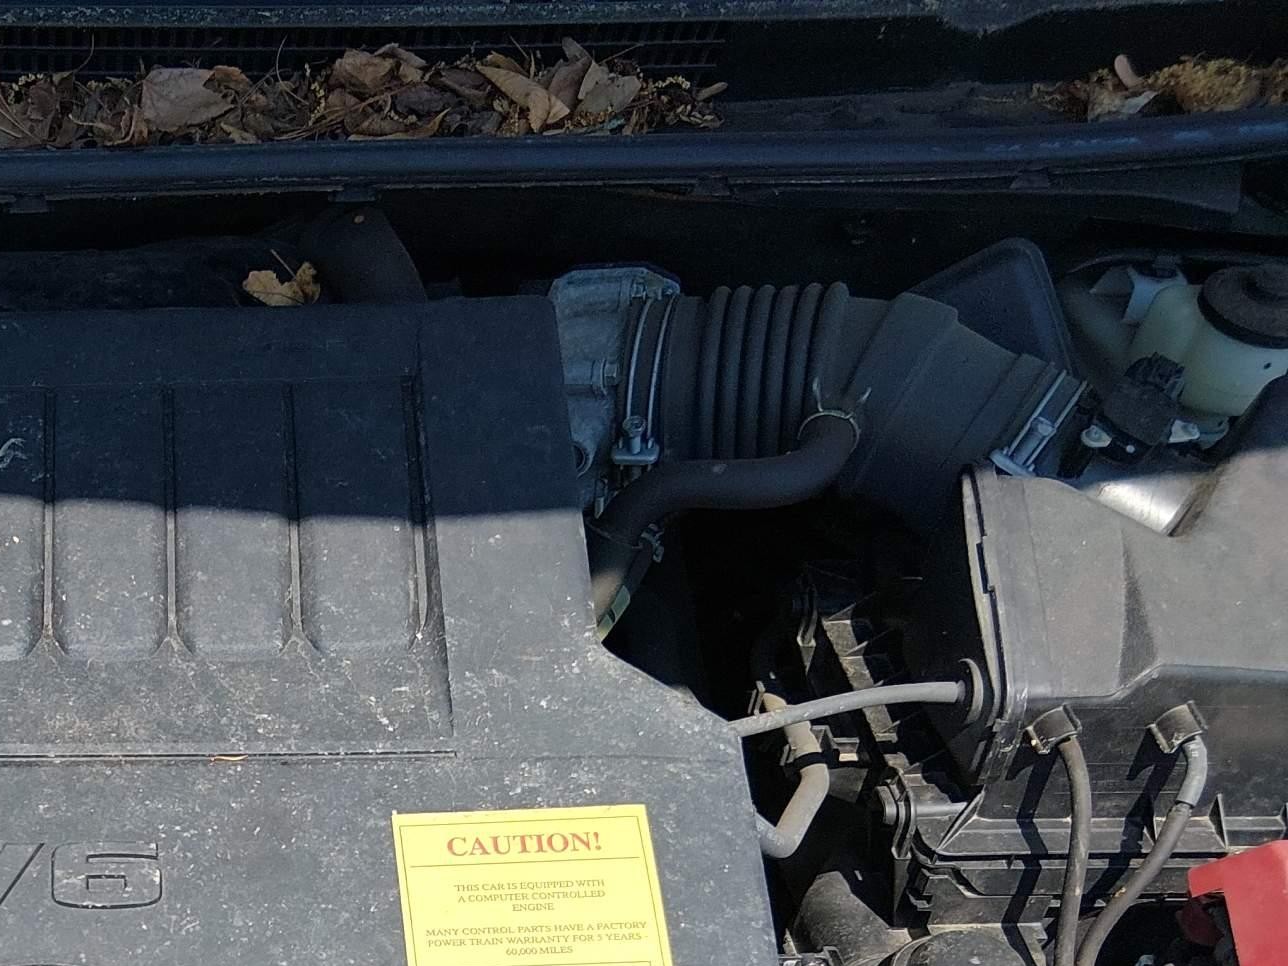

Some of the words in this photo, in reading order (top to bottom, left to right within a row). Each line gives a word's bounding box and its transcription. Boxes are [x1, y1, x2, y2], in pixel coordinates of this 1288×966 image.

[446, 831, 602, 857] CAUTION!
[454, 883, 479, 892] THIS
[481, 882, 505, 892] CAR
[507, 882, 518, 891] IS
[519, 880, 574, 890] EQUIPPED
[575, 879, 605, 888] WITH
[458, 895, 466, 904] A
[468, 893, 529, 903] COMPUTER
[531, 890, 606, 901] CONTROLLED
[512, 903, 555, 912] ENGINE
[425, 927, 459, 937] MANY
[462, 926, 515, 935] CONTROL
[517, 925, 552, 933] PARTS
[554, 923, 584, 932] HAVE
[586, 923, 594, 931] A
[427, 938, 467, 948] POWER
[468, 937, 503, 946] TRAIN
[506, 934, 570, 944] WARRANTY
[572, 934, 593, 942] FOR
[596, 933, 603, 941] 5
[605, 932, 642, 941] YEARS
[505, 947, 538, 956] 60,000
[539, 946, 574, 954] MILES
